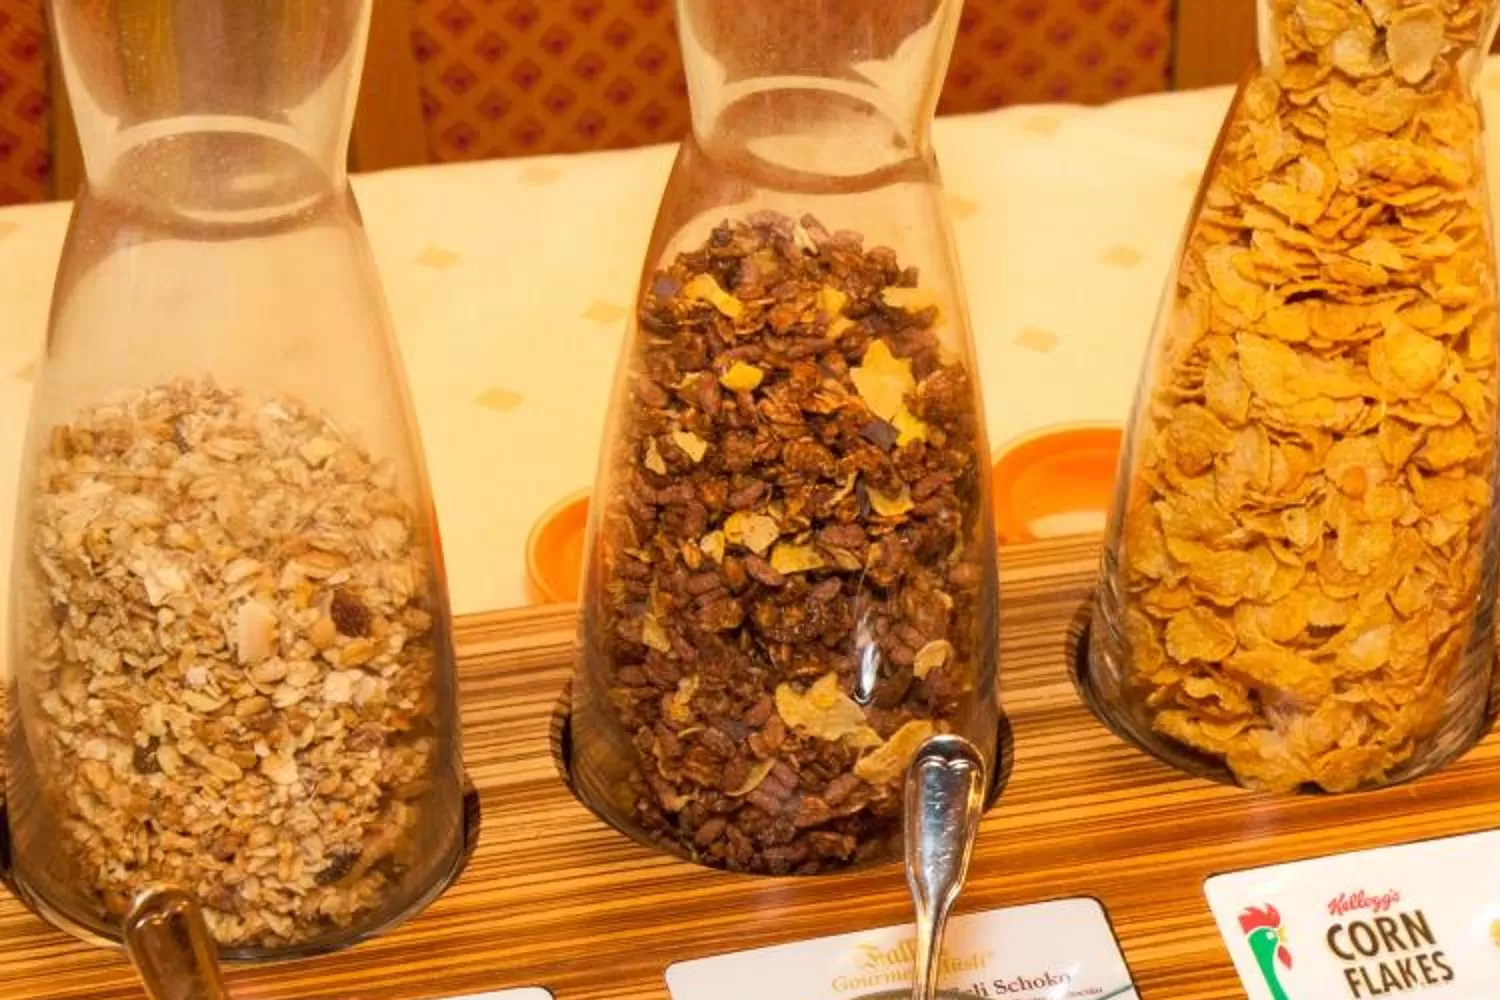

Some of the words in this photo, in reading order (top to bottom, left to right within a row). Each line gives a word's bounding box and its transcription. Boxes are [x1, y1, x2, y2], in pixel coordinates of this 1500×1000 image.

[1327, 889, 1401, 916] Kellogg's
[1326, 909, 1437, 961] CORN
[994, 966, 1071, 996] Schoko
[1343, 951, 1455, 999] FLAKES
